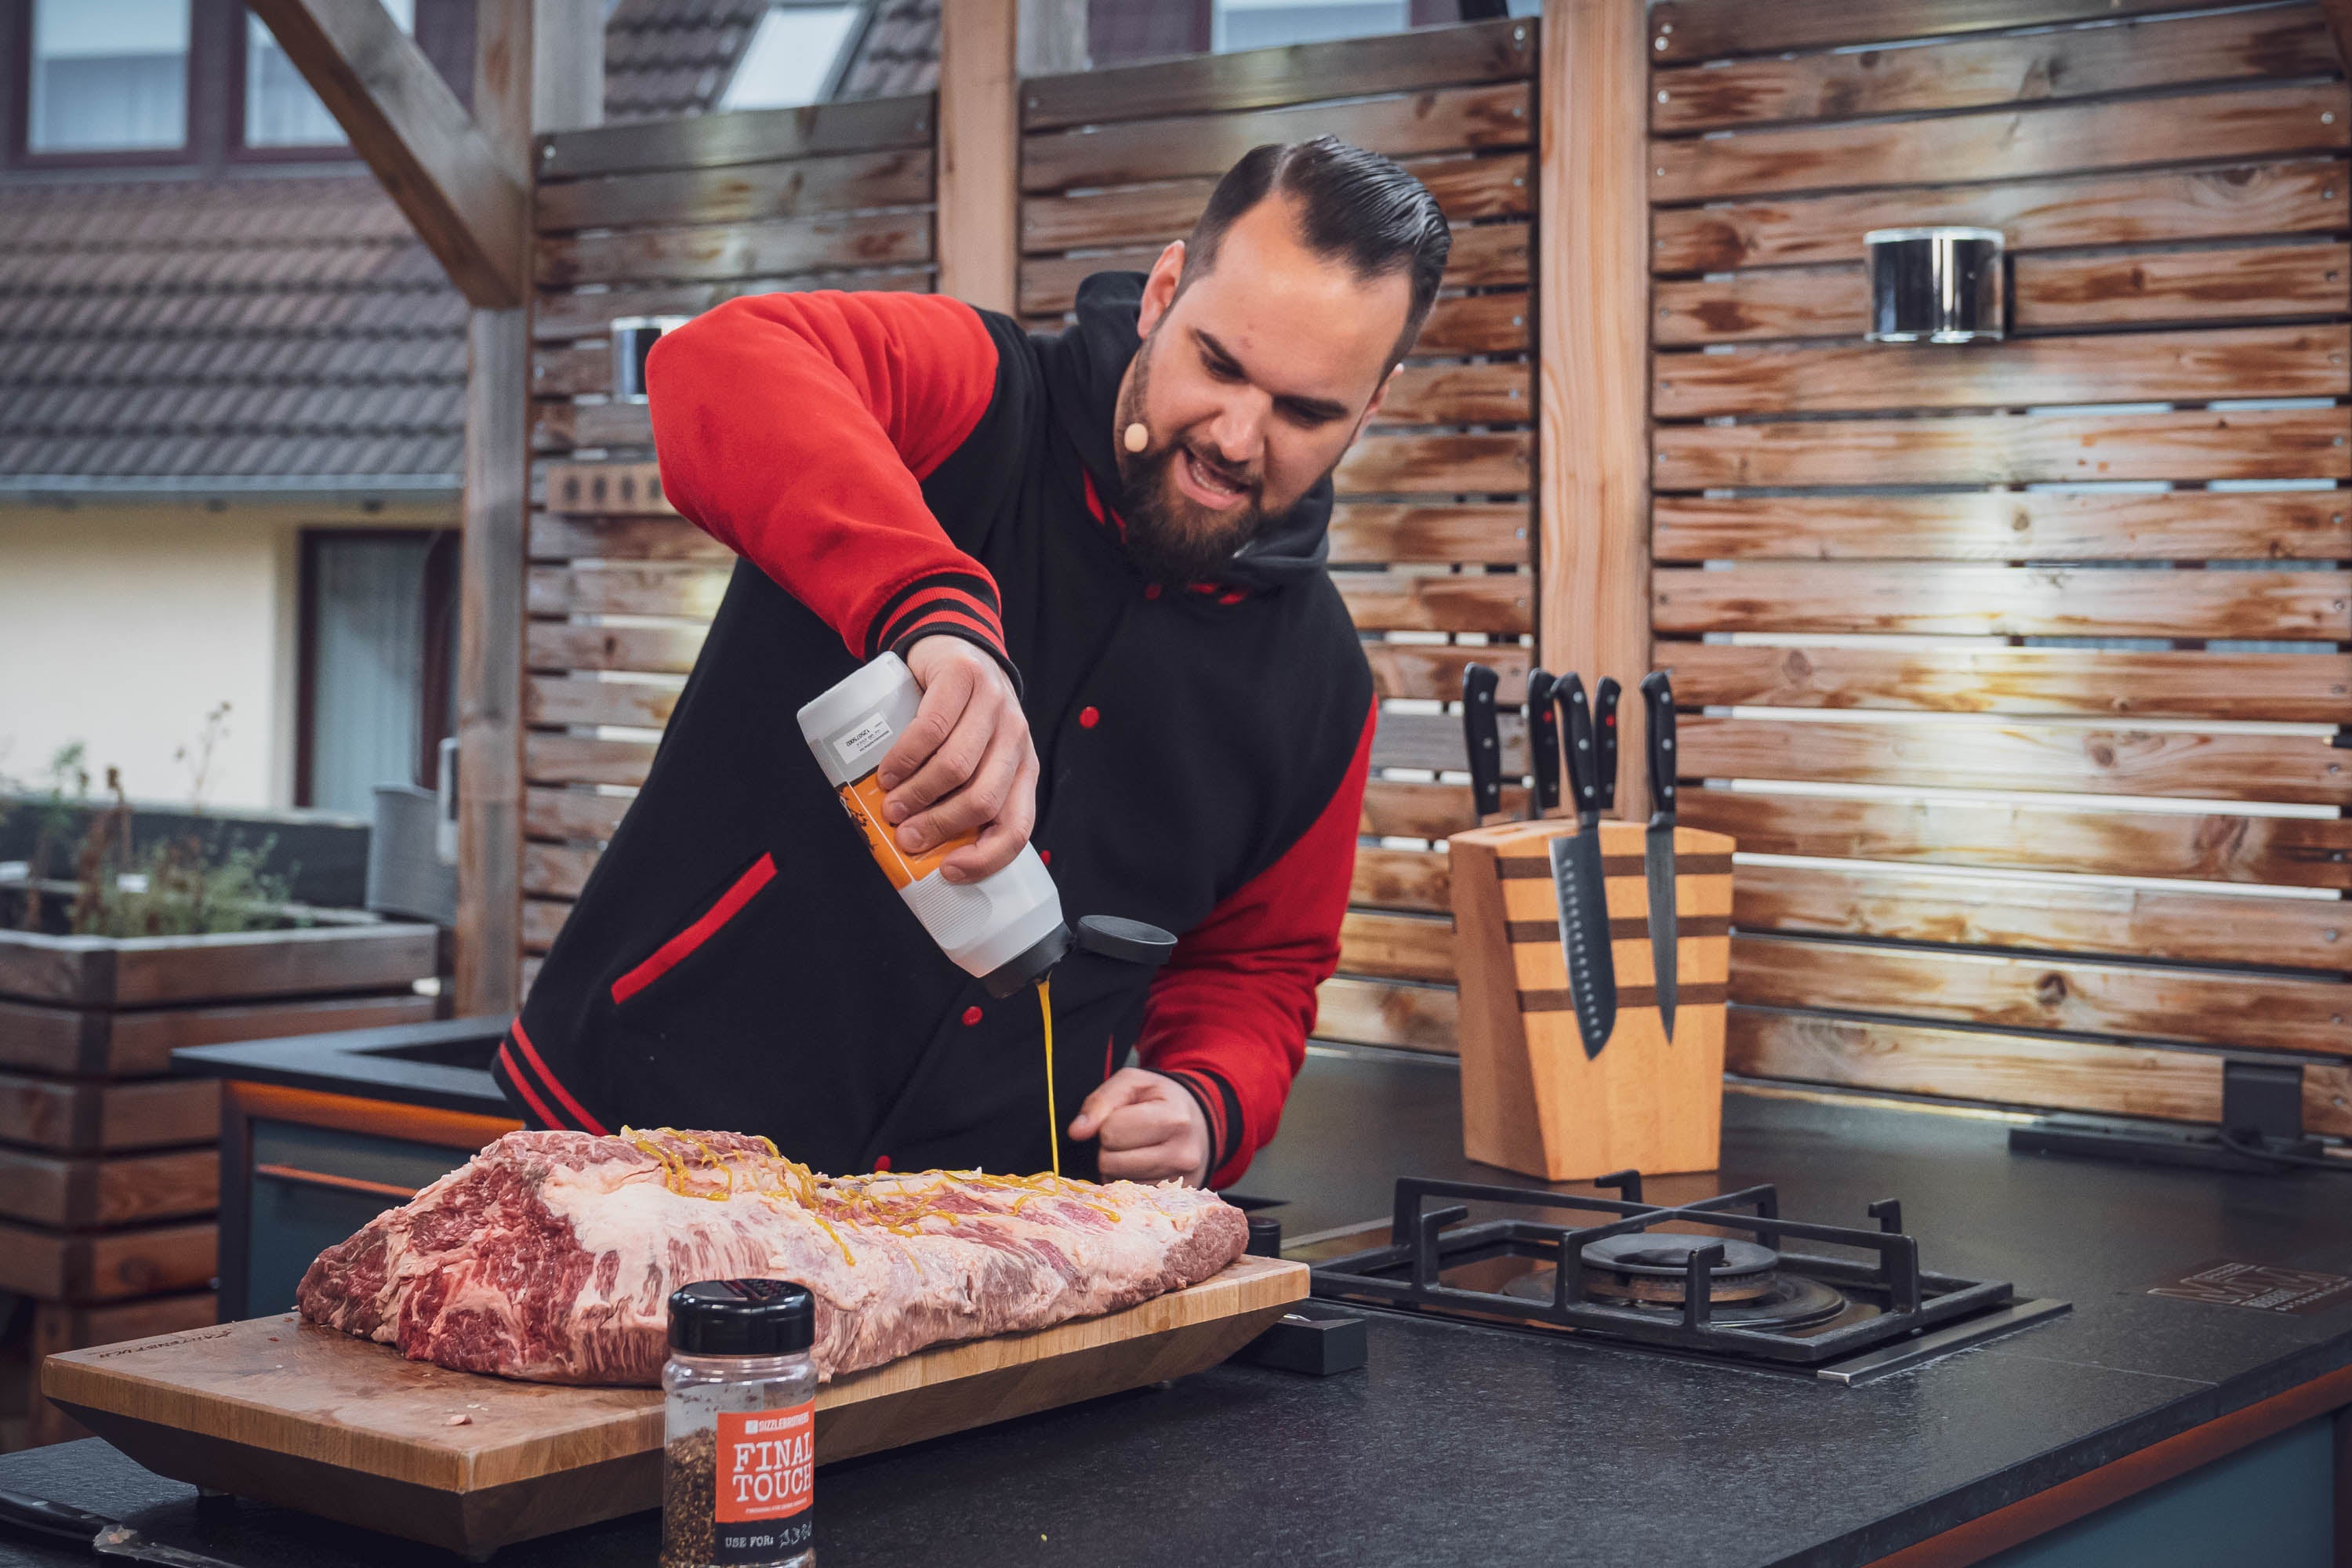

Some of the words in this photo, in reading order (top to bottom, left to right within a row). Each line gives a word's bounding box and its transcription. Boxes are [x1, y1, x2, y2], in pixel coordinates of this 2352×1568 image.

[733, 1432, 812, 1473] FINAL
[733, 1463, 811, 1502] TOUCH
[725, 1537, 747, 1548] USE
[750, 1534, 774, 1548] FOR:
